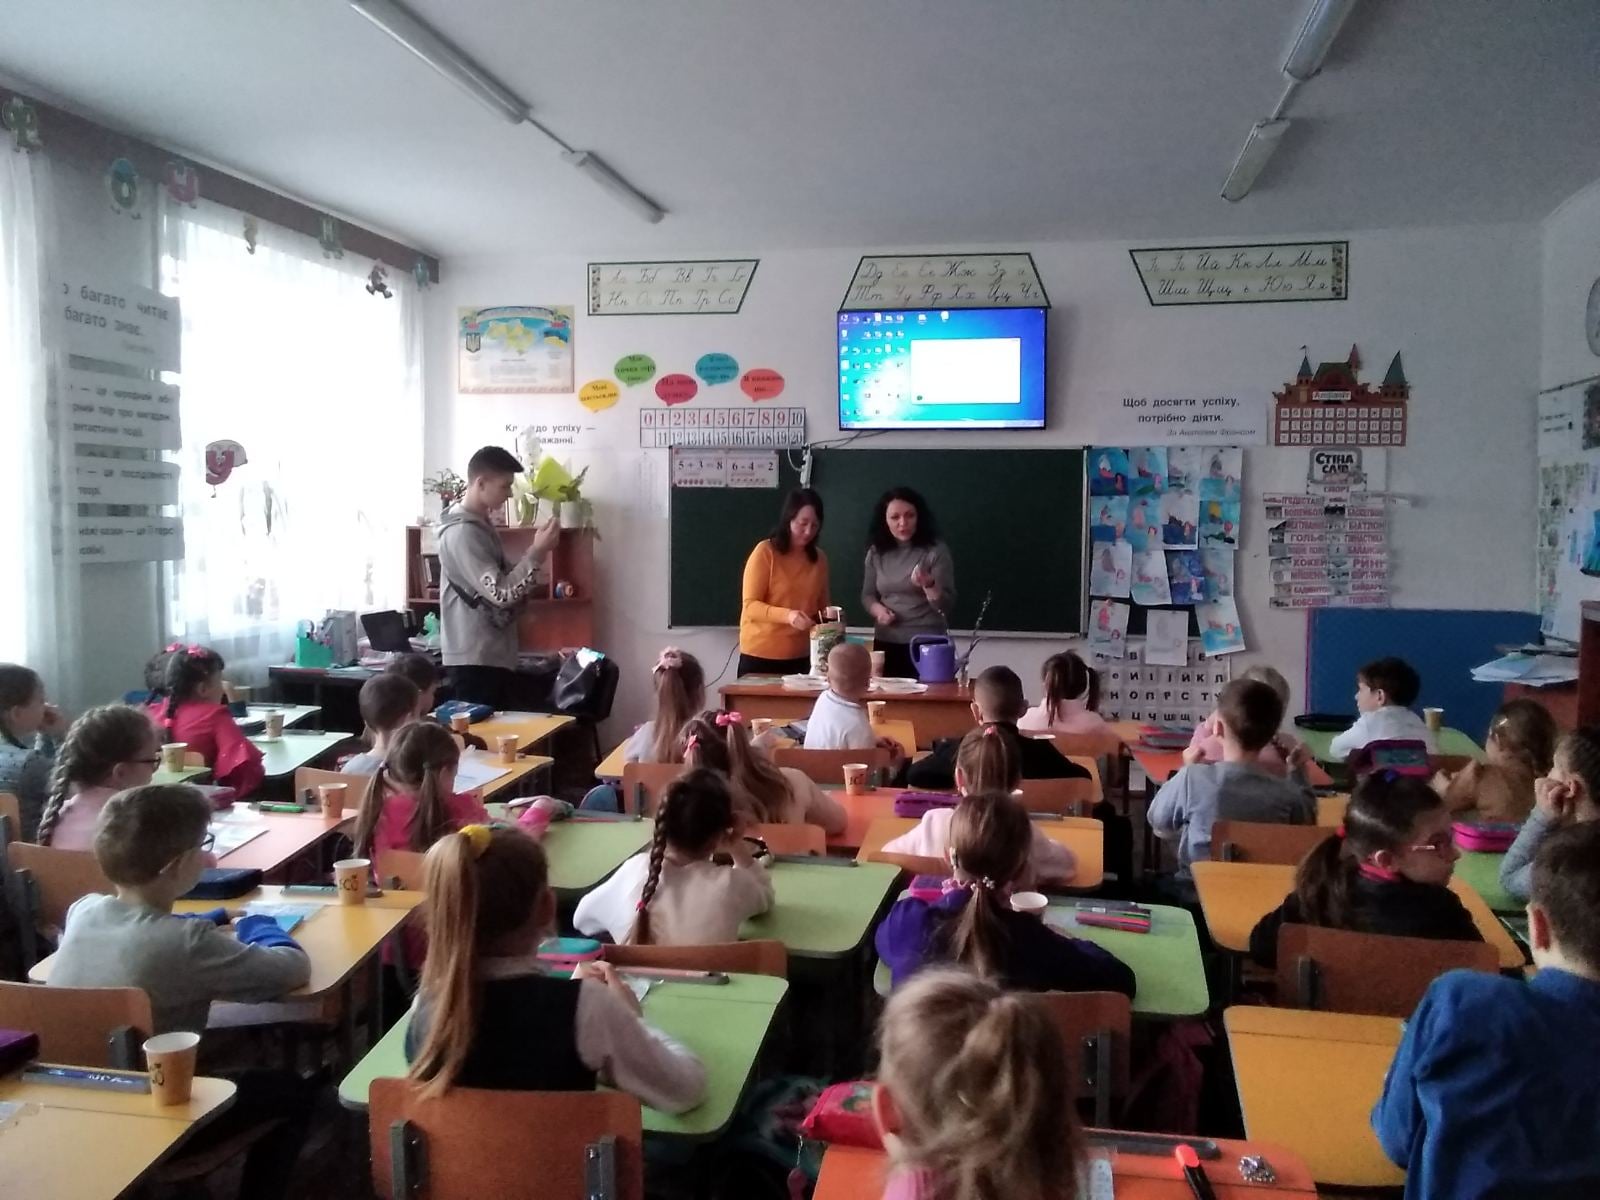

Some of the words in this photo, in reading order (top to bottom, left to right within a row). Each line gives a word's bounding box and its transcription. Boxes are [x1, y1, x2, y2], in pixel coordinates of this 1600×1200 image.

[80, 285, 126, 309] багато
[64, 306, 107, 328] багато
[1123, 397, 1147, 408] Щоб
[1153, 398, 1196, 408] досягти
[1202, 396, 1240, 408] успіху,
[644, 412, 652, 425] 0
[659, 412, 665, 425] 1
[674, 412, 681, 425] 2
[688, 412, 696, 425] 3
[703, 412, 710, 425] 4
[717, 412, 725, 425] 5
[732, 412, 740, 425] 6
[747, 412, 755, 425] 7
[762, 412, 770, 425] 8
[777, 412, 786, 425] 9
[791, 412, 803, 424] 10
[1138, 413, 1186, 424] потрібно
[1192, 413, 1224, 424] діяти.
[535, 425, 547, 434] до
[552, 424, 581, 434] успіху
[658, 432, 667, 446] 11
[672, 432, 682, 446] 12
[686, 432, 697, 446] 13
[701, 432, 712, 446] 14
[716, 432, 727, 446] 15
[731, 432, 742, 446] 16
[746, 432, 757, 446] 17
[761, 432, 772, 446] 18
[776, 432, 787, 446] 19
[790, 431, 804, 445] 20
[679, 461, 684, 470] 5
[699, 461, 704, 470] 3
[716, 461, 723, 470] 8
[732, 462, 738, 471] 6
[749, 461, 755, 471] 4
[768, 462, 774, 471] 2
[1130, 672, 1139, 680] И
[1129, 691, 1138, 699] О
[1146, 692, 1154, 700] П
[1164, 691, 1171, 700] Р
[1181, 692, 1189, 700] С
[1201, 692, 1209, 700] Т
[1131, 712, 1140, 721] Ц
